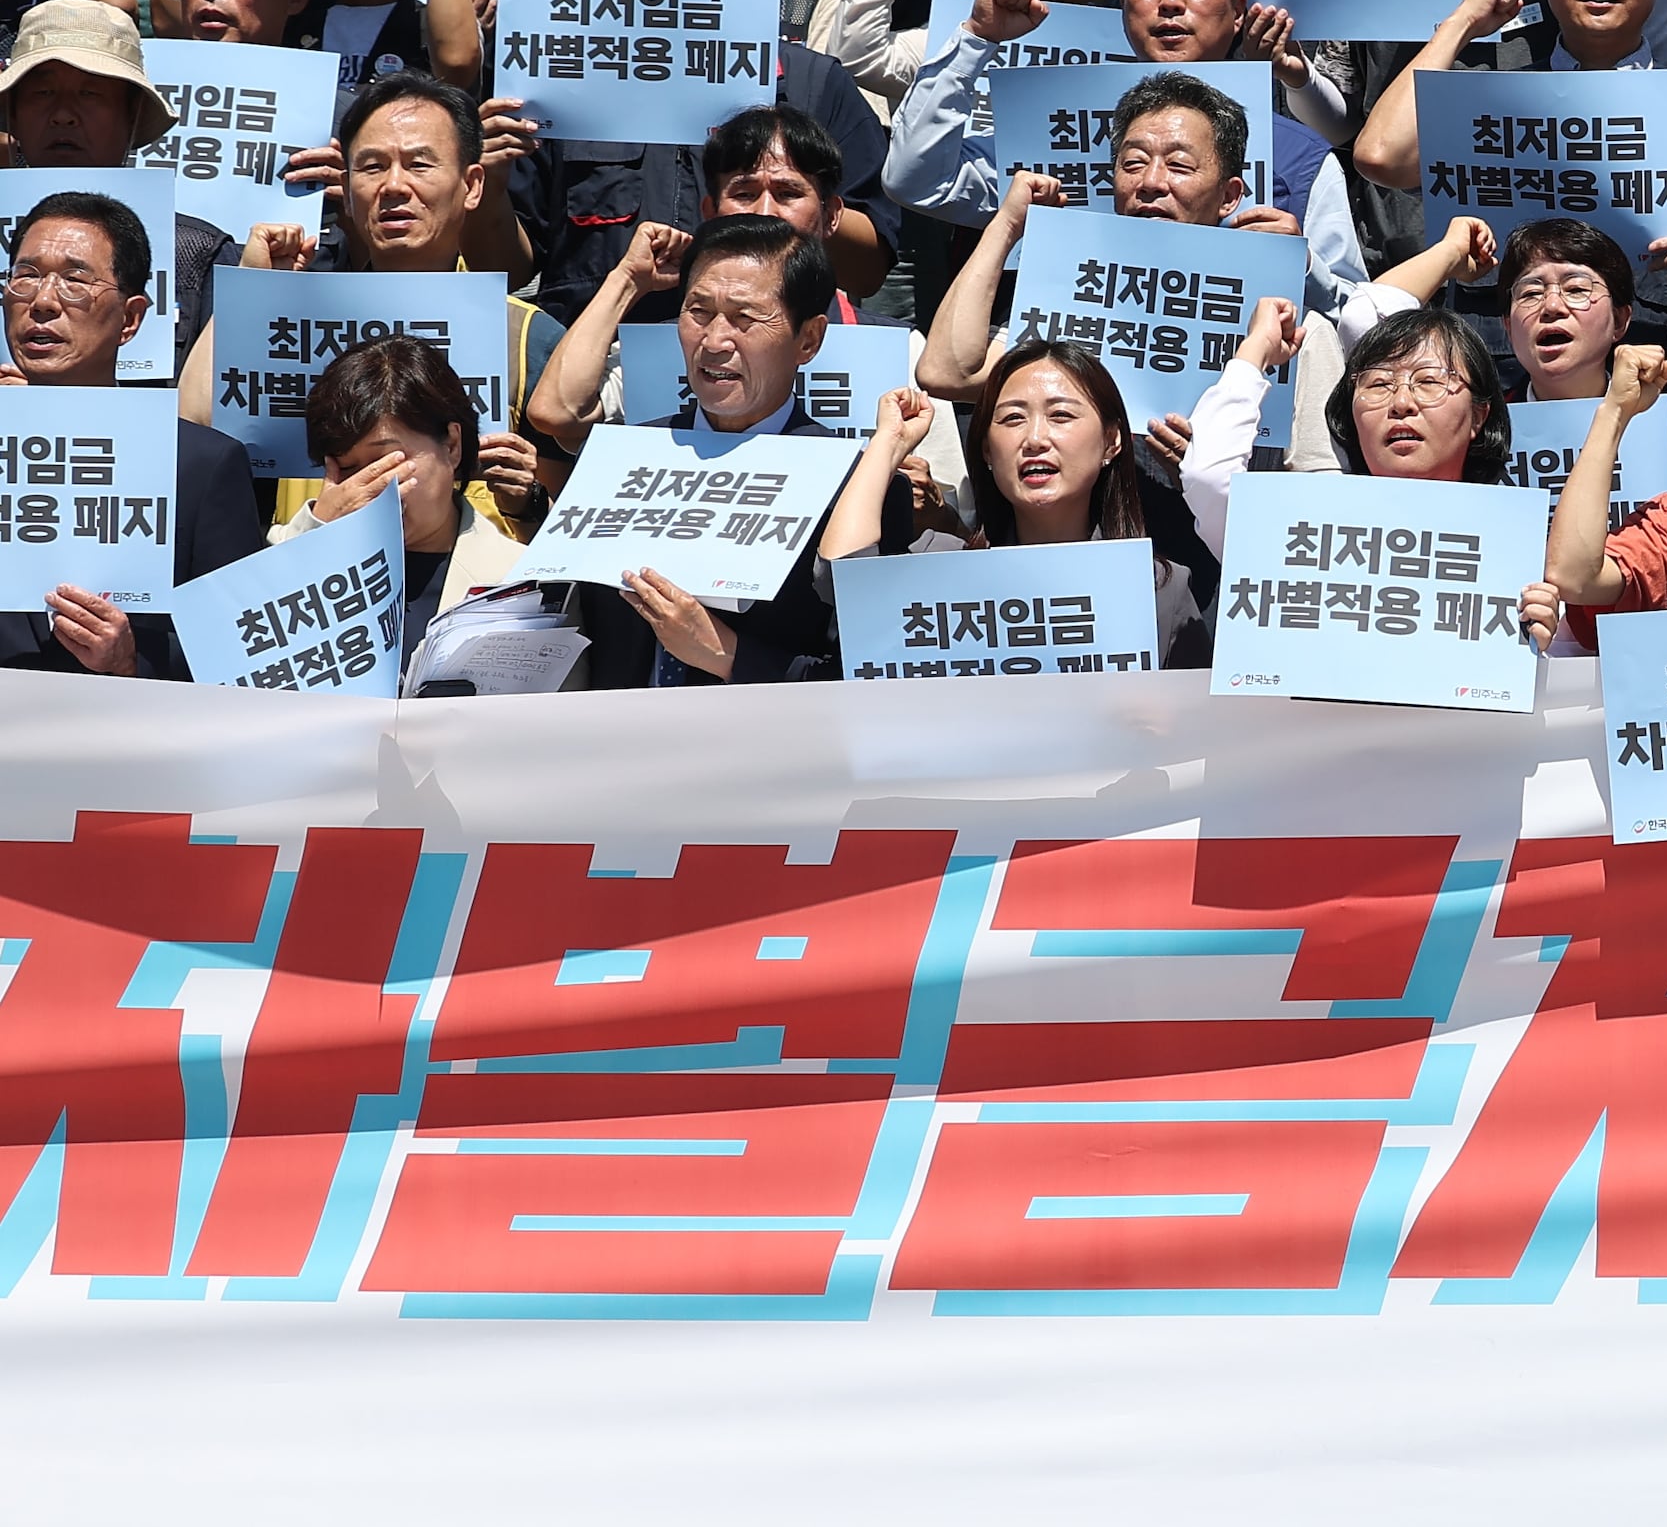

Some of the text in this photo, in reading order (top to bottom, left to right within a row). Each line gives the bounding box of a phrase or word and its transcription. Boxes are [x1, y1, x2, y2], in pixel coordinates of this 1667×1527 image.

[502, 31, 771, 86] 차별적용 폐지
[1473, 115, 1647, 161] 최저임금
[1428, 161, 1599, 212] 차별적용
[614, 467, 789, 506] 최저임금
[547, 506, 813, 551] 차별적용 폐지
